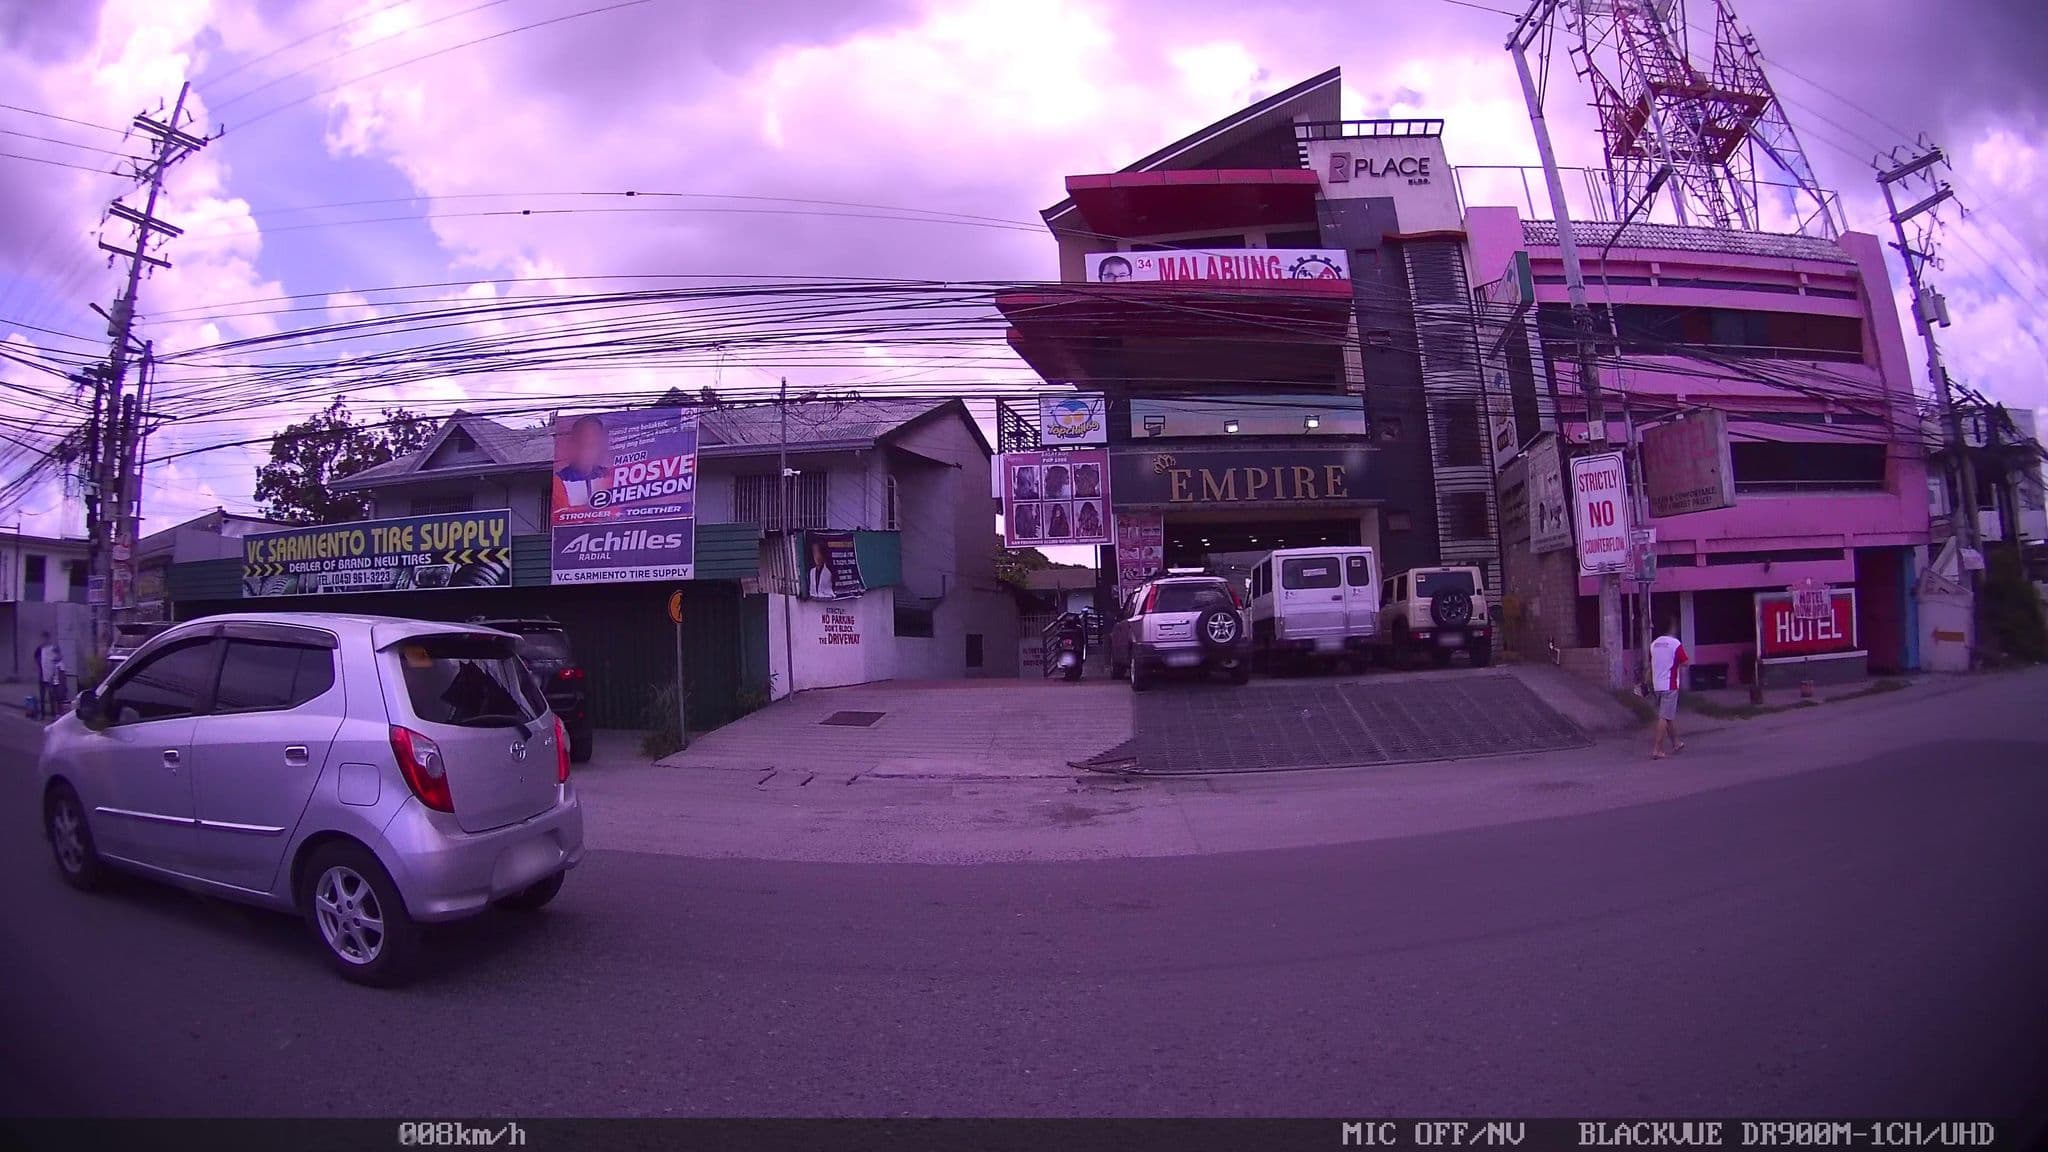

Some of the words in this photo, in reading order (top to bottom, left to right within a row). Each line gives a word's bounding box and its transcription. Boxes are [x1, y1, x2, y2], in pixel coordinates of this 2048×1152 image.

[1354, 157, 1431, 178] PLACE
[1138, 258, 1152, 269] 34
[614, 451, 647, 466] MAYOR
[613, 453, 695, 488] ROSVE
[1578, 469, 1618, 492] STRICTLY
[611, 476, 693, 503] HENSON
[1168, 465, 1348, 502] EMPIRE
[559, 511, 611, 521] STRONGER
[626, 505, 682, 516] TOGETHER
[1588, 500, 1615, 528] NO
[247, 539, 265, 563] VC
[268, 529, 365, 562] SARMIENTO
[371, 525, 413, 554] TIRE
[420, 518, 505, 551] SUPPLY
[561, 530, 682, 554] Achilles
[1584, 537, 1626, 554] COUNTERFLOW
[289, 561, 321, 573] DEALER
[323, 560, 336, 571] OF
[338, 558, 371, 570] BRAND
[374, 555, 399, 568] NEW
[401, 553, 432, 566] TIRES
[578, 553, 611, 561] RADIAL
[575, 570, 627, 581] SARMIENTO
[630, 569, 651, 579] TIRE
[653, 568, 688, 578] SUPPLY
[822, 615, 831, 624] NO
[831, 615, 855, 625] PARKING
[828, 633, 860, 645] DRIVEWAY
